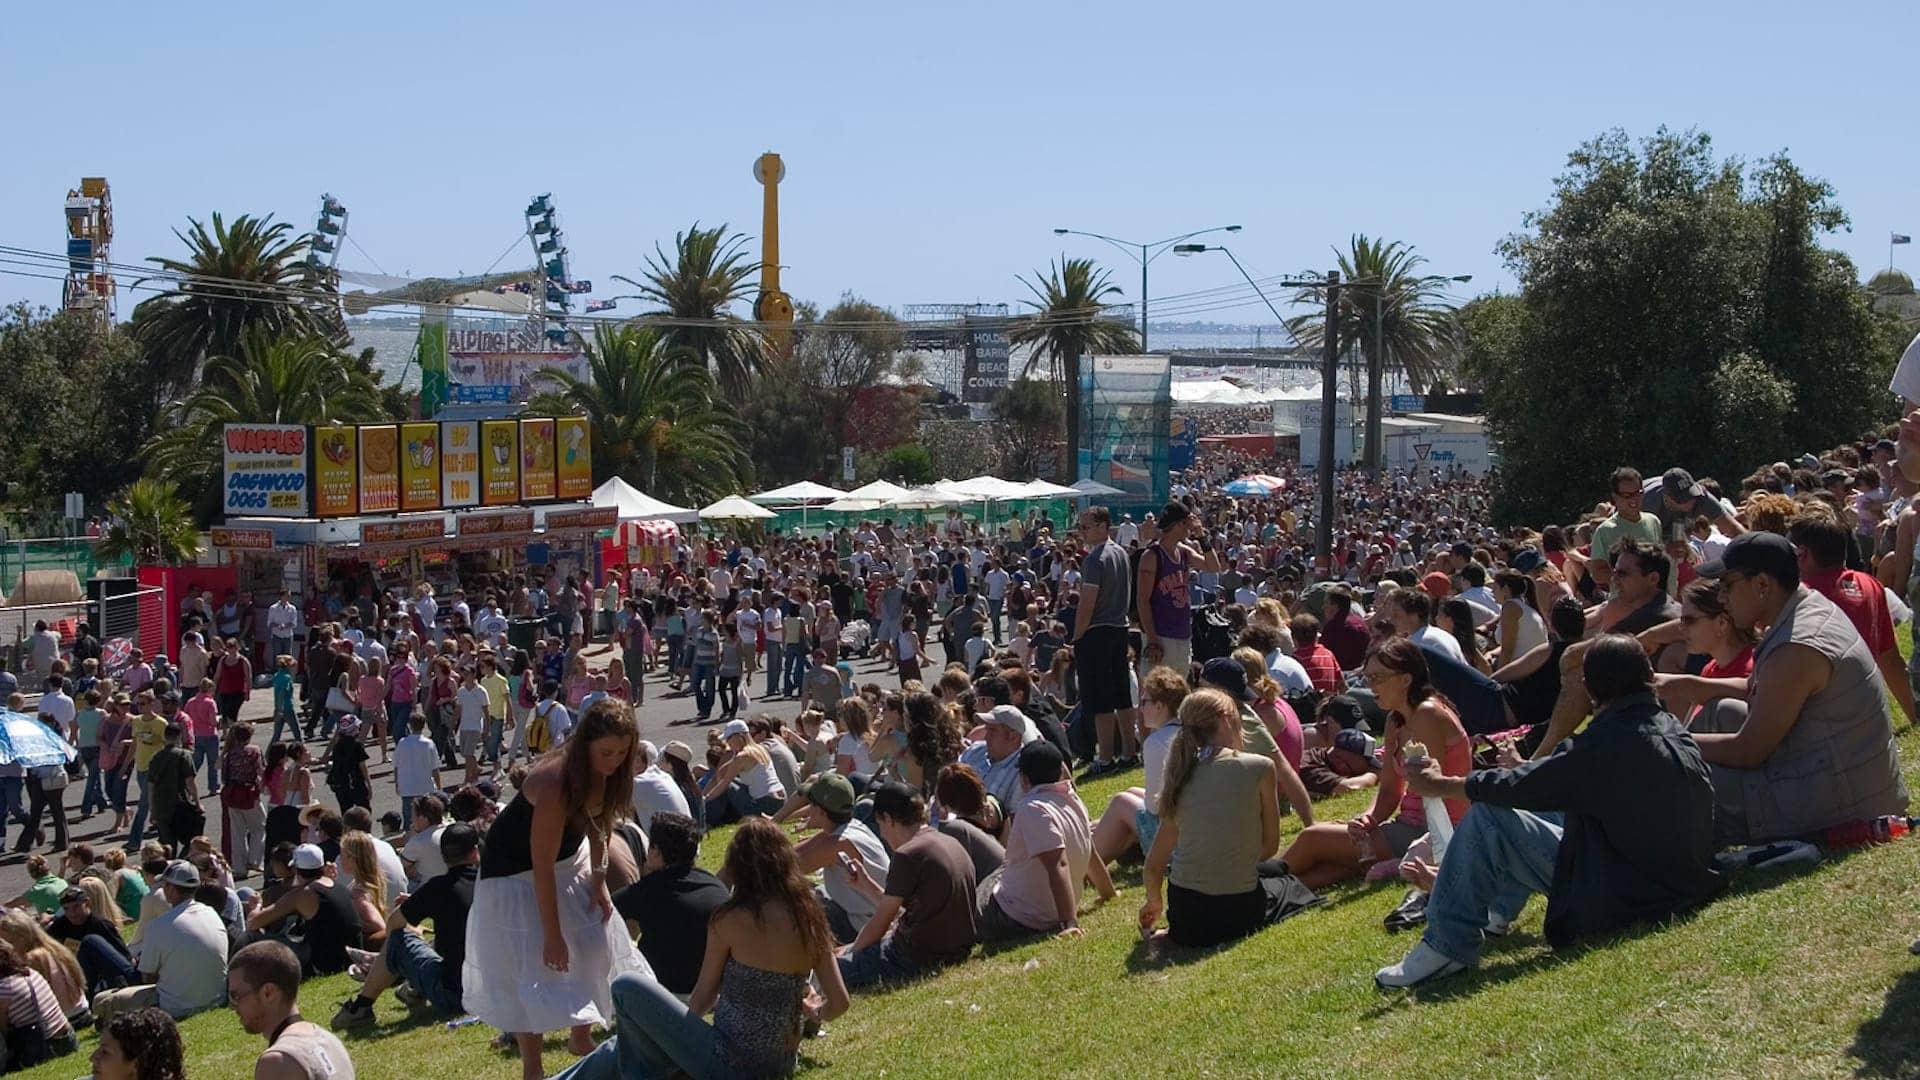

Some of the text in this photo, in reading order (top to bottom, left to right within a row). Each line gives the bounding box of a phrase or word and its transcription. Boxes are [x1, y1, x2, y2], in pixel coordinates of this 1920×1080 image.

[225, 427, 305, 455] WAFFLES
[1430, 449, 1457, 463] Thrifty
[228, 472, 305, 491] DAGWOOD
[364, 474, 398, 490] DONUTS
[228, 490, 268, 507] DOGS
[326, 495, 349, 507] FOOD
[364, 491, 399, 509] DONUTS
[231, 536, 270, 548] DONUTS
